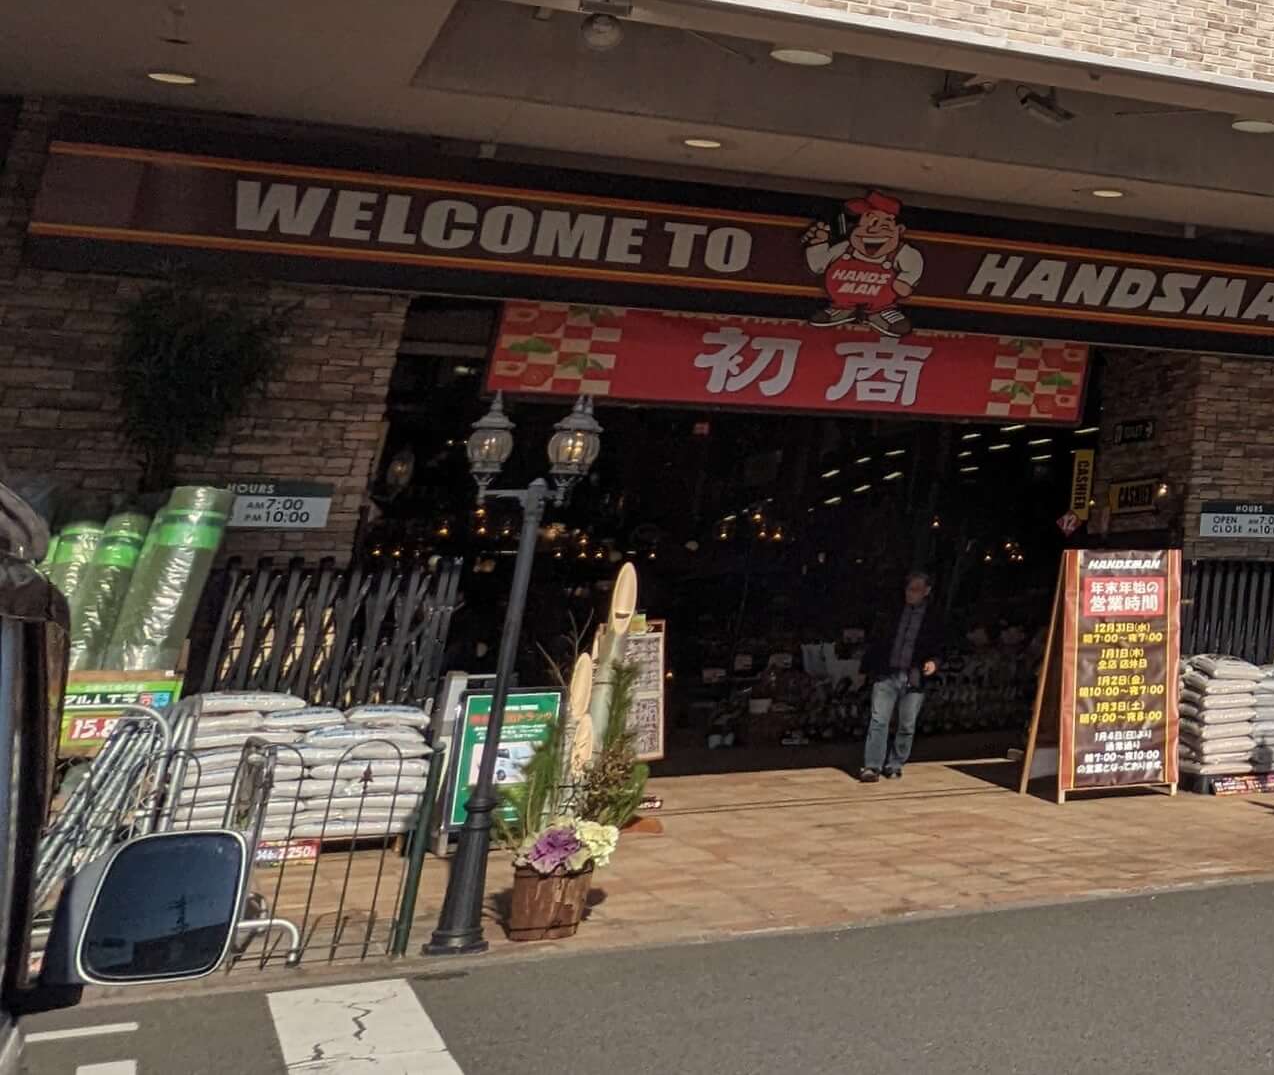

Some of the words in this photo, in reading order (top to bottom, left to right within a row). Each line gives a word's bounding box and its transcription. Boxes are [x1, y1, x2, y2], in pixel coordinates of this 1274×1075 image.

[234, 179, 650, 264] WELCOME
[664, 222, 753, 273] TO
[831, 268, 892, 285] HANDS
[837, 281, 882, 297] MAN
[693, 326, 933, 406] 初商
[1235, 504, 1264, 513] HOURS
[1213, 515, 1239, 524] OPEN
[1212, 525, 1243, 534] CLOSE
[1088, 559, 1161, 570] HANDSMAN
[1090, 581, 1159, 594] 年末年始の
[1089, 594, 1158, 612] 営業時間
